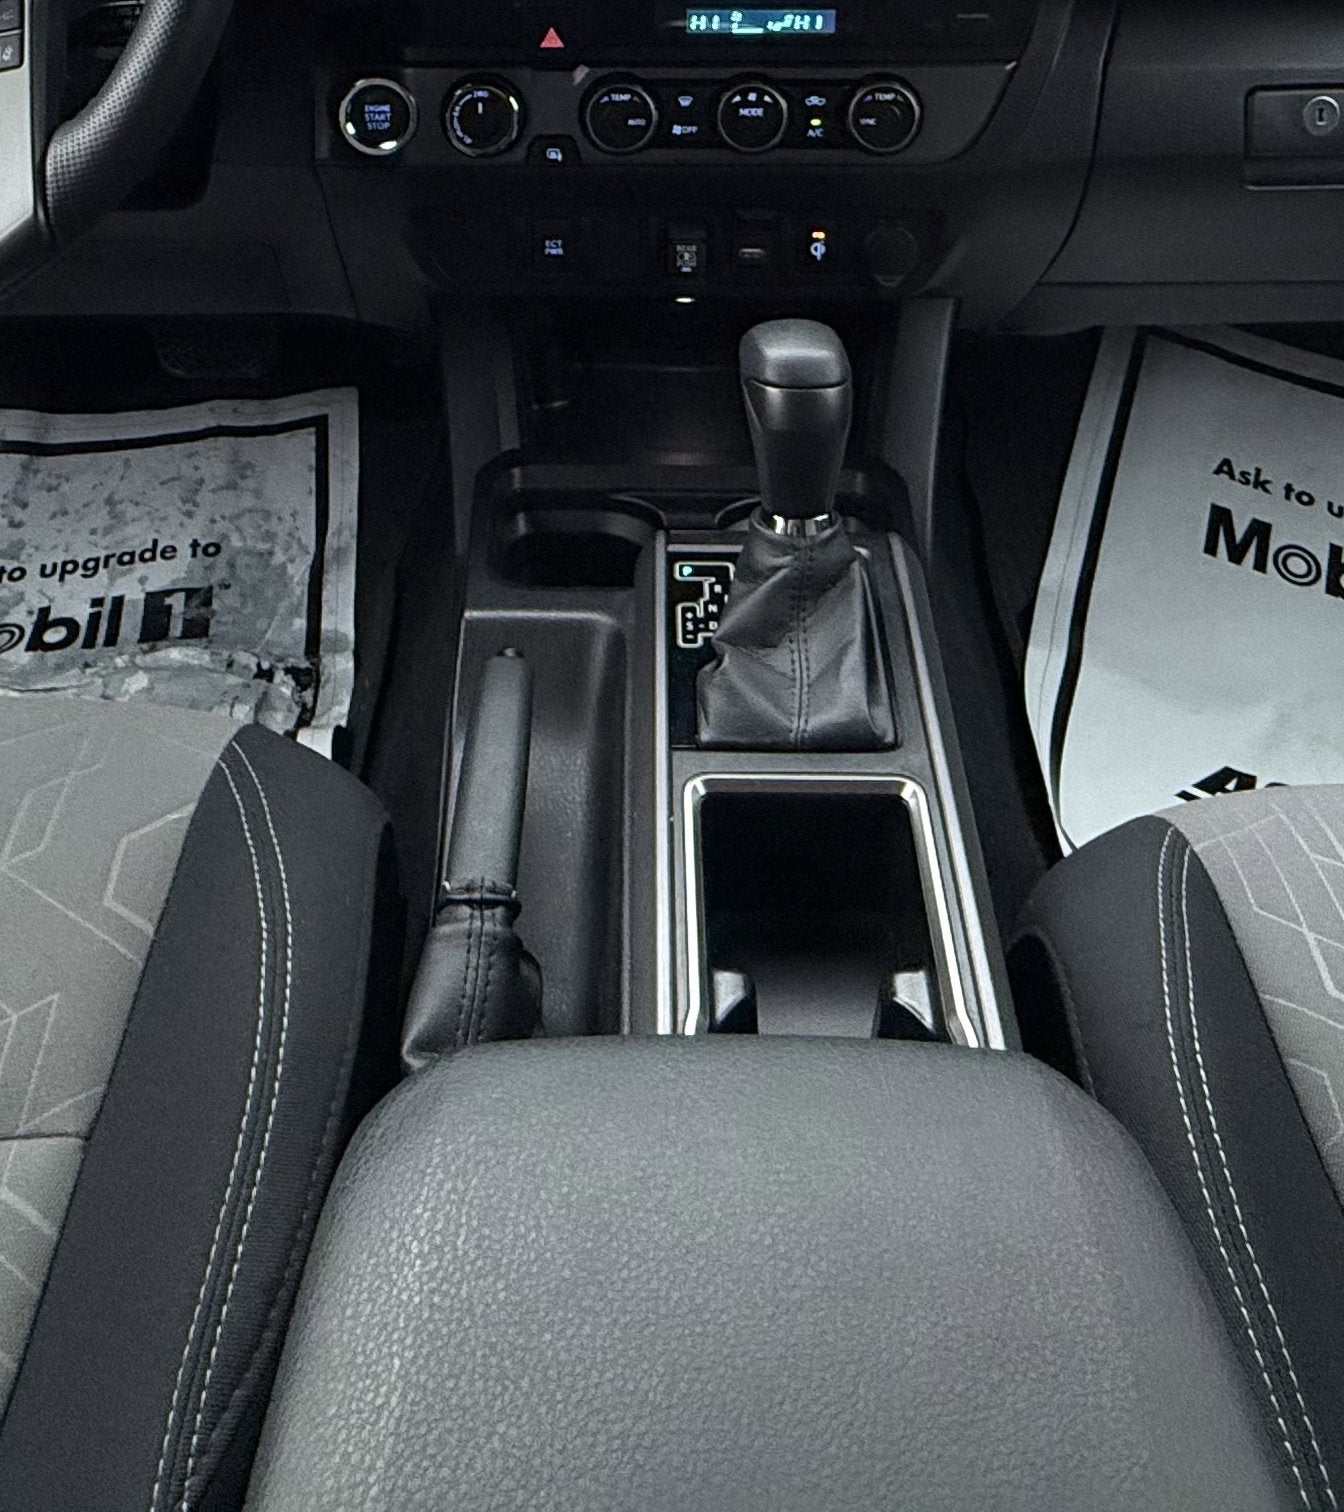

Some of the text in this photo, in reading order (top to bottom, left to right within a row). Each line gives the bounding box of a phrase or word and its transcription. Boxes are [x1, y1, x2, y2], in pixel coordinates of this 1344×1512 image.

[610, 93, 632, 102] TEMP
[874, 92, 896, 101] TEMP
[364, 104, 391, 112] ENGINE
[739, 108, 764, 117] MODE
[364, 112, 391, 121] START
[367, 121, 391, 130] STOP
[682, 126, 698, 135] OFF
[806, 128, 824, 137] A/C
[545, 240, 563, 248] ECT
[544, 248, 565, 256] PWR
[1213, 455, 1272, 496] Ask
[1284, 481, 1316, 509] to
[38, 538, 178, 589] upgrade
[188, 536, 223, 559] to
[713, 584, 722, 593] R
[707, 603, 718, 613] N
[685, 621, 694, 631] S
[708, 620, 718, 630] D
